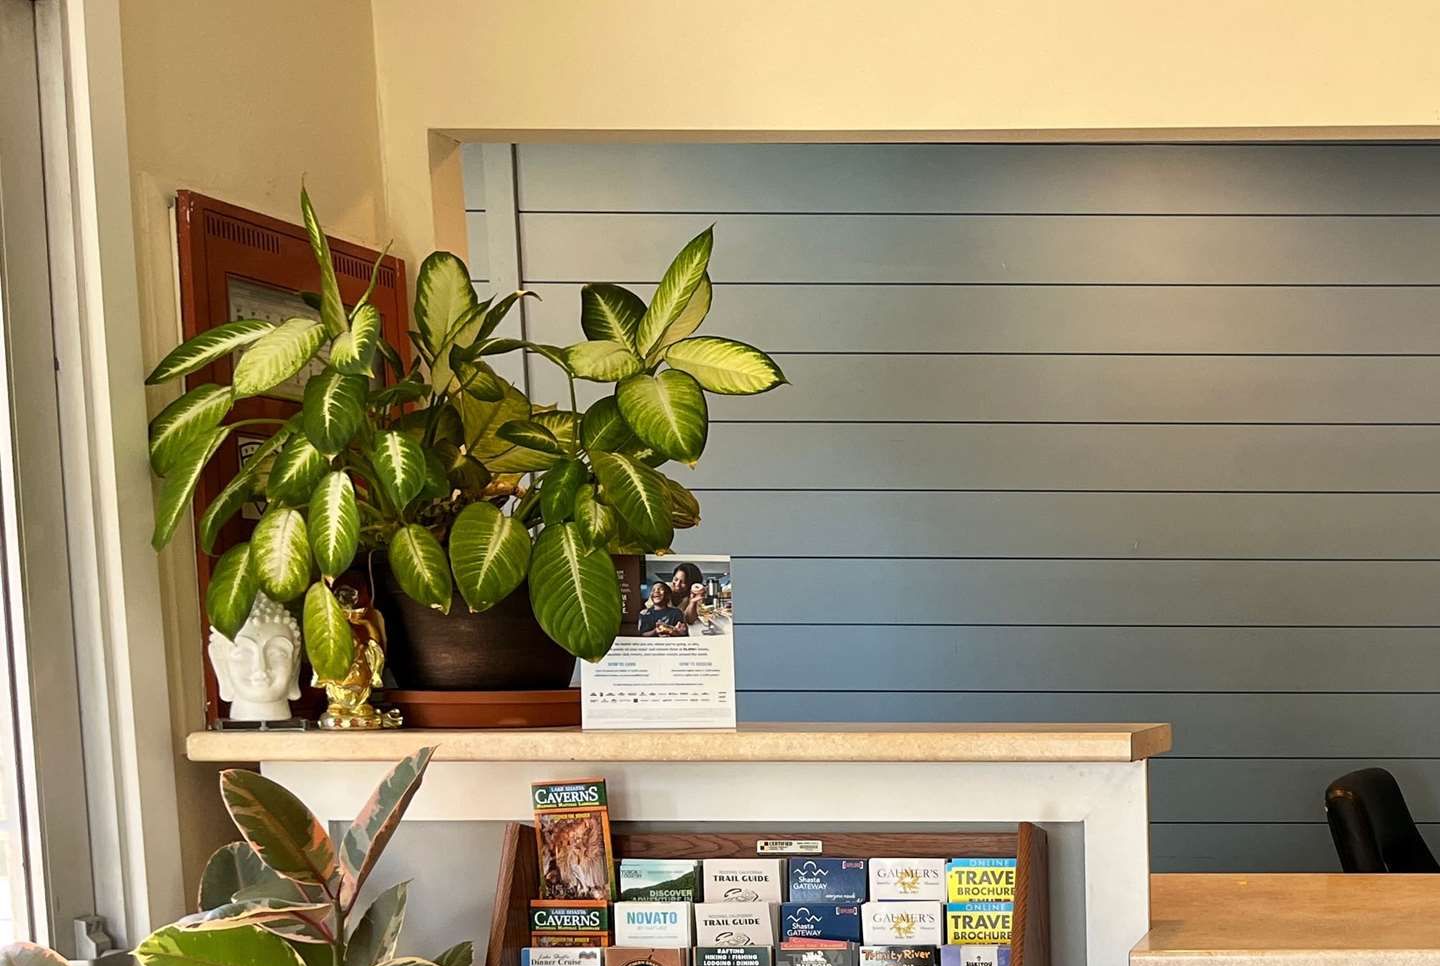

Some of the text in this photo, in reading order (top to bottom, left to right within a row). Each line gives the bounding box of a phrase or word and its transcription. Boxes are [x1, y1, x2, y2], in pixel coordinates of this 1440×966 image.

[535, 787, 599, 806] CAVERNS
[955, 871, 1014, 885] TRAVE
[534, 909, 599, 927] CAVERNS
[627, 912, 677, 924] NOVATO
[952, 915, 1010, 929] TRAVE
[863, 950, 930, 960] Trinity River
